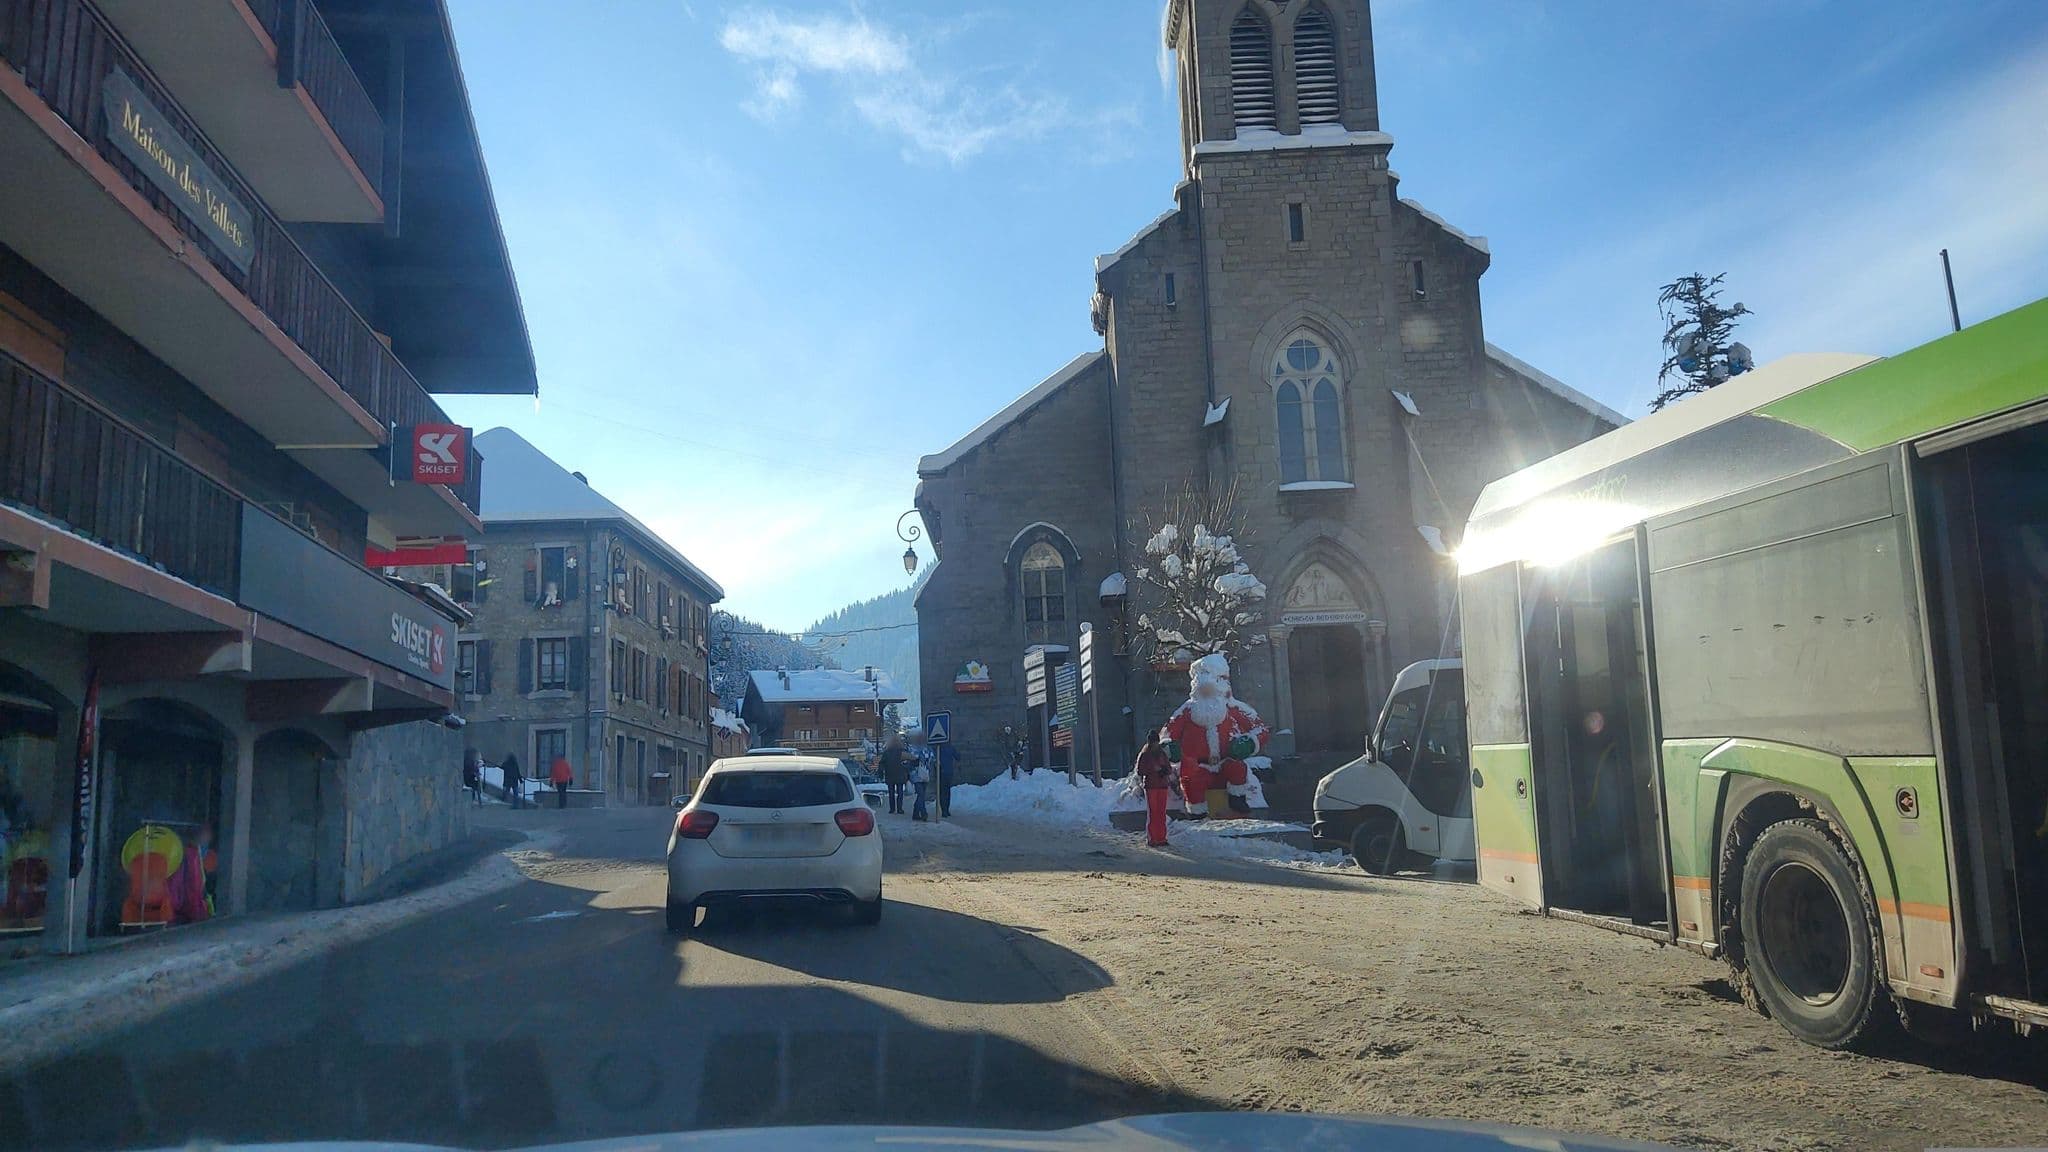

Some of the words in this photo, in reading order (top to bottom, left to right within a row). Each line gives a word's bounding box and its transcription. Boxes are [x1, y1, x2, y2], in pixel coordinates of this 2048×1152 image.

[123, 101, 176, 180] Maison
[179, 165, 200, 203] des
[205, 188, 242, 247] Vallets
[418, 465, 458, 474] SKISET
[391, 612, 432, 657] SKISET
